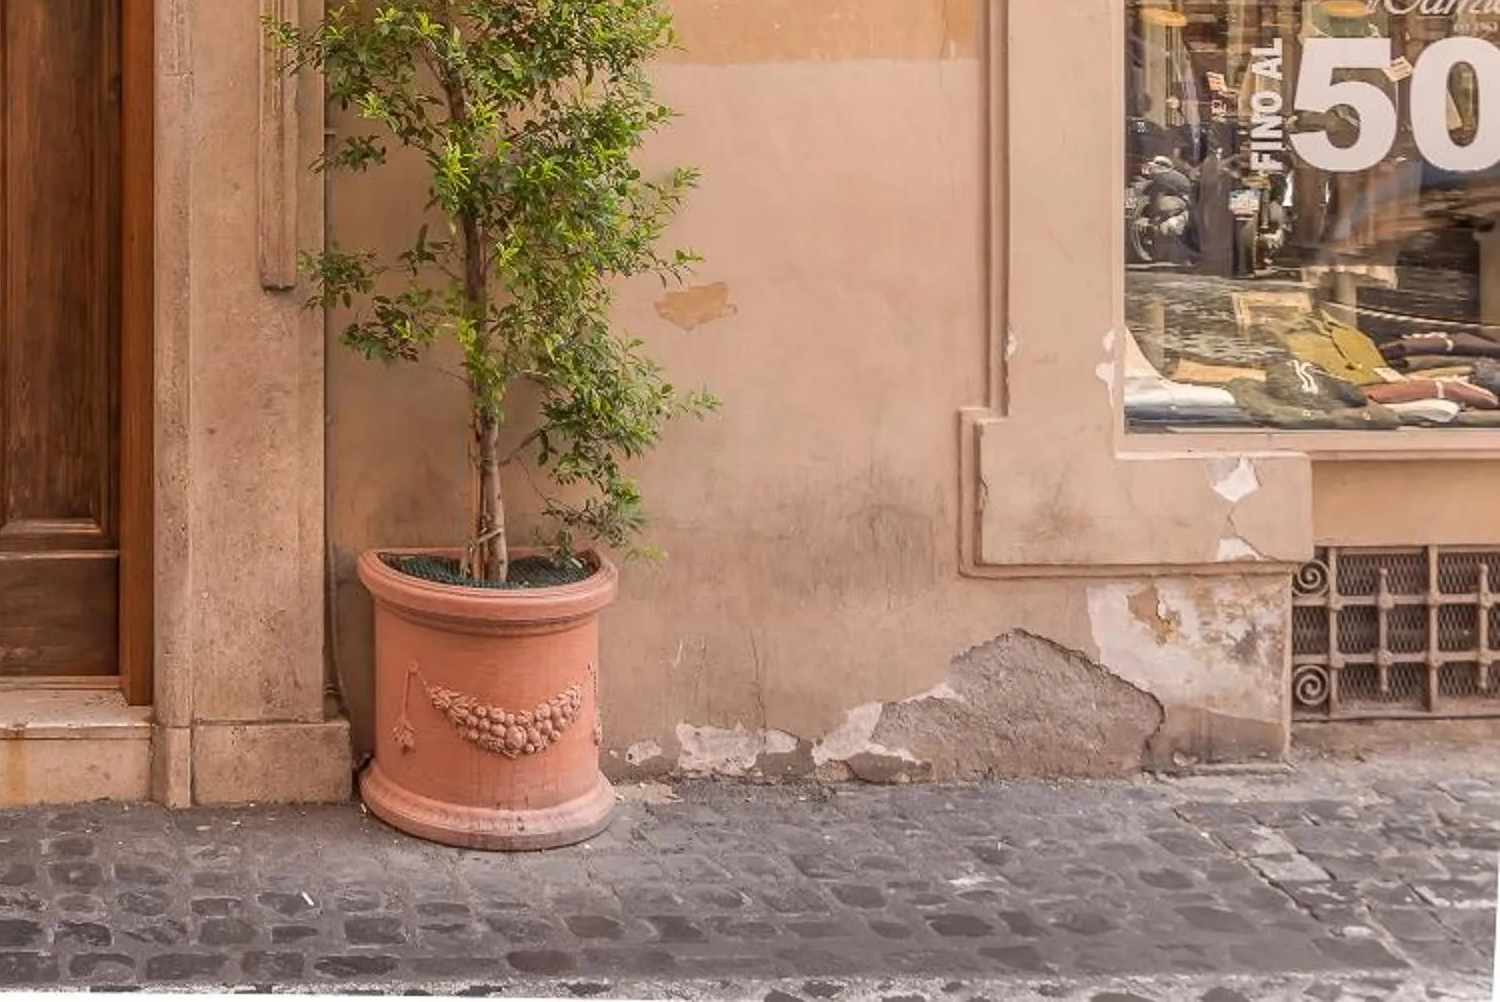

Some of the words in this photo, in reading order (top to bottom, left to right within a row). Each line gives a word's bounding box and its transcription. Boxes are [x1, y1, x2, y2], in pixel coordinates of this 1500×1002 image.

[1252, 37, 1284, 81] AL
[1252, 90, 1284, 172] FINO
[1290, 35, 1500, 173] 50
